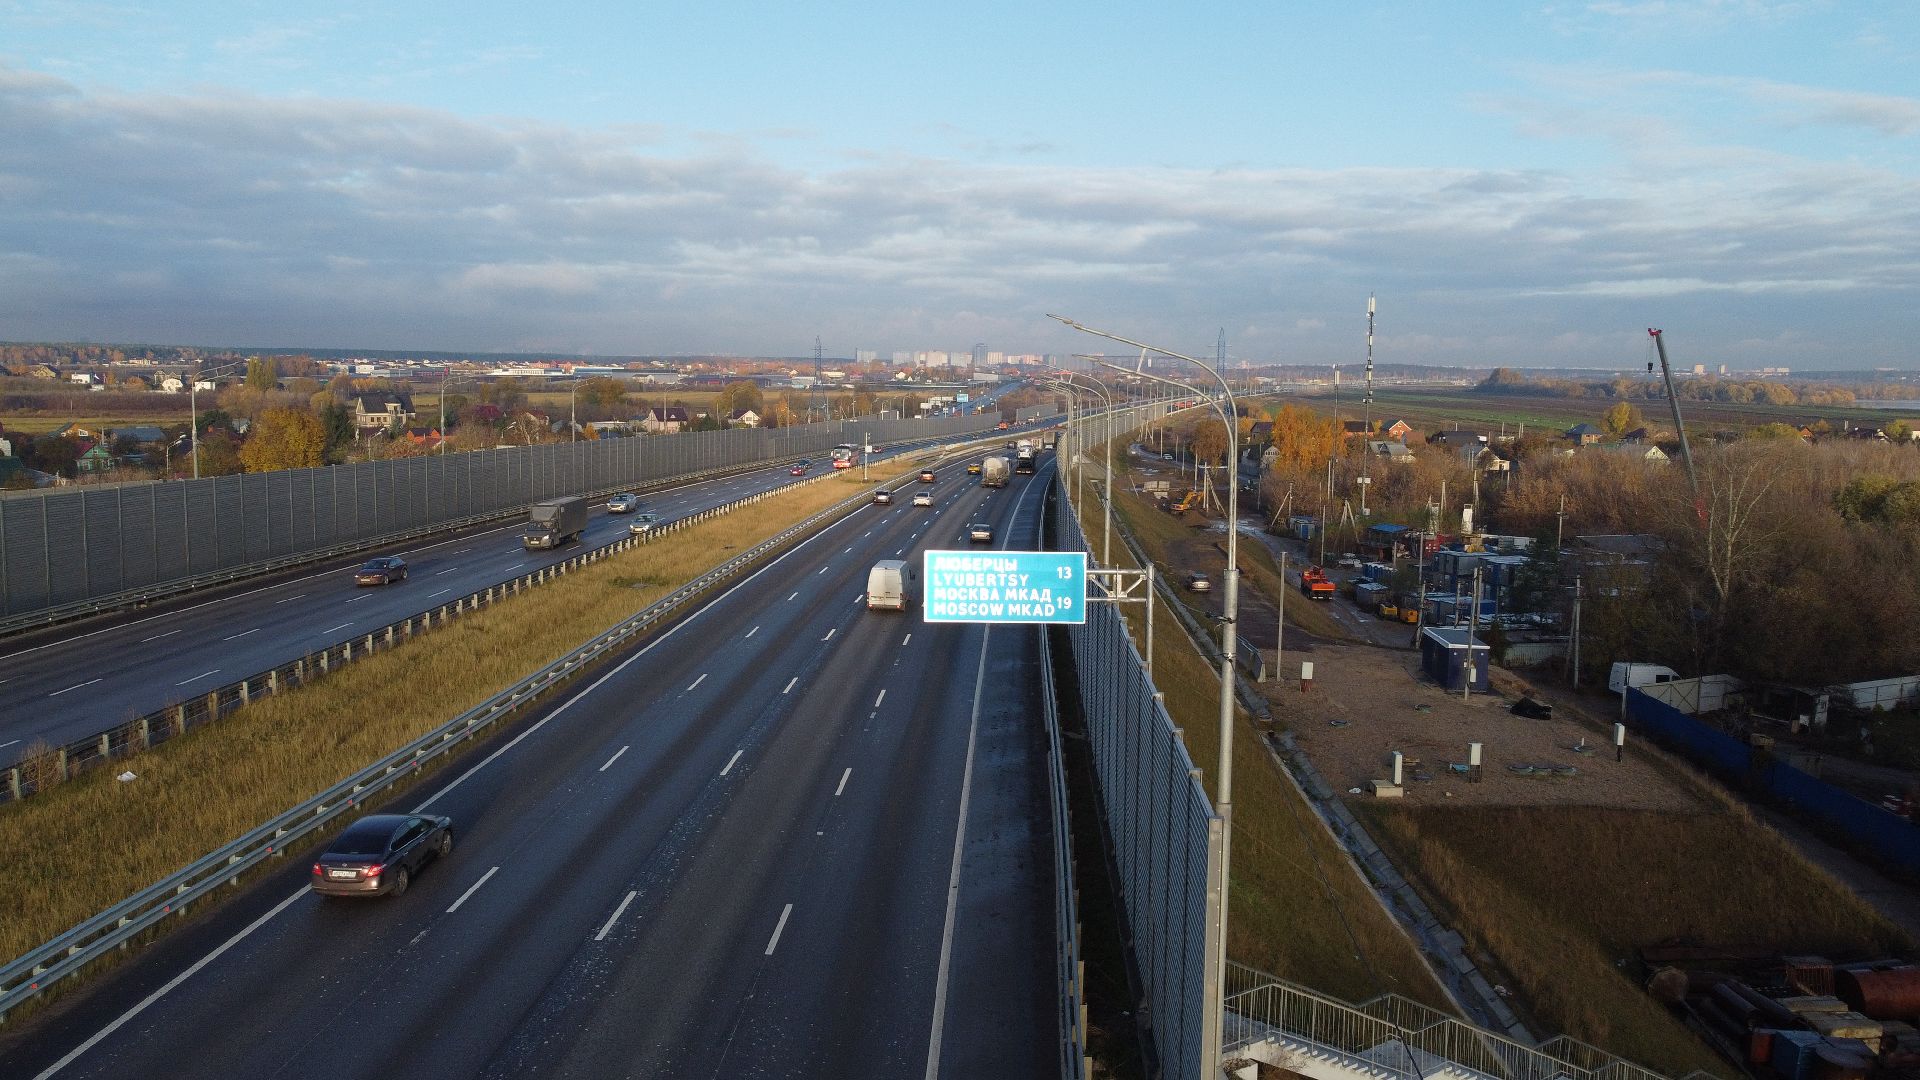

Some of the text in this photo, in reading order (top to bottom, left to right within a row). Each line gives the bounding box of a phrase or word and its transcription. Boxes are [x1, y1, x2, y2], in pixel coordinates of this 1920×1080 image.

[934, 557, 1018, 573] ЛЮБЕРЦЫ
[1057, 566, 1072, 579] 13
[933, 573, 1029, 587] LYUBERTSY
[933, 588, 1052, 603] МОСКВА МКАД
[933, 602, 1055, 617] MOSCOW MKAD
[1057, 596, 1072, 610] 19
